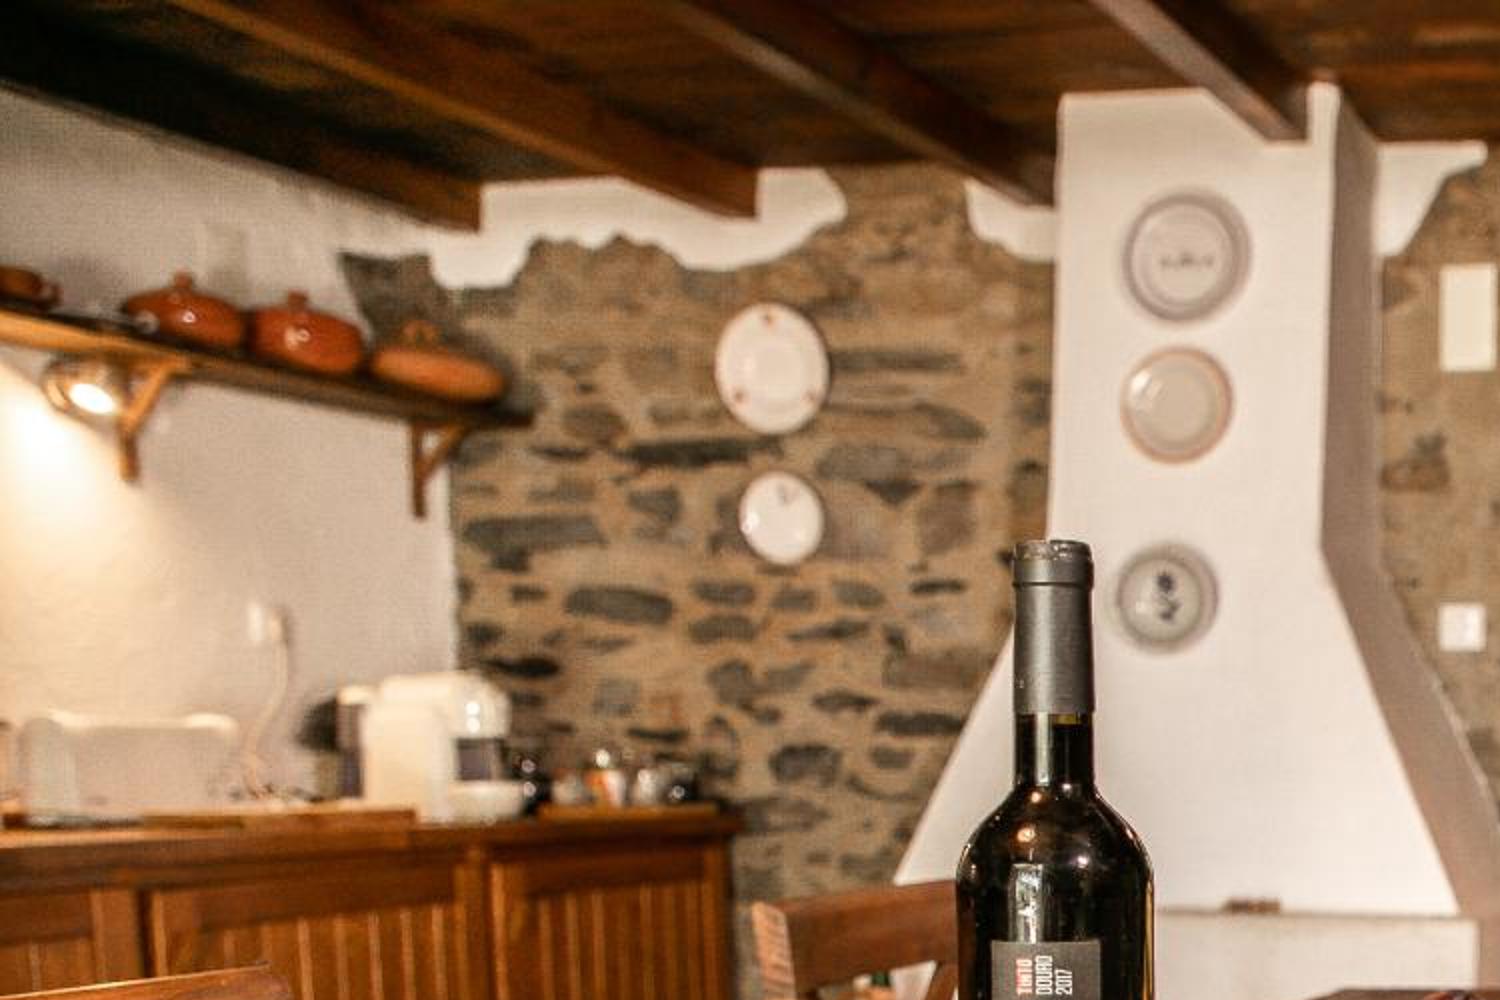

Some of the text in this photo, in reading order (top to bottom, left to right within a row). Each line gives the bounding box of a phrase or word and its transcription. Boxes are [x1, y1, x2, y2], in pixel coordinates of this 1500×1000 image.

[1016, 958, 1033, 995] TINTO
[1035, 955, 1053, 995] DOURO
[1055, 969, 1073, 995] 2017
